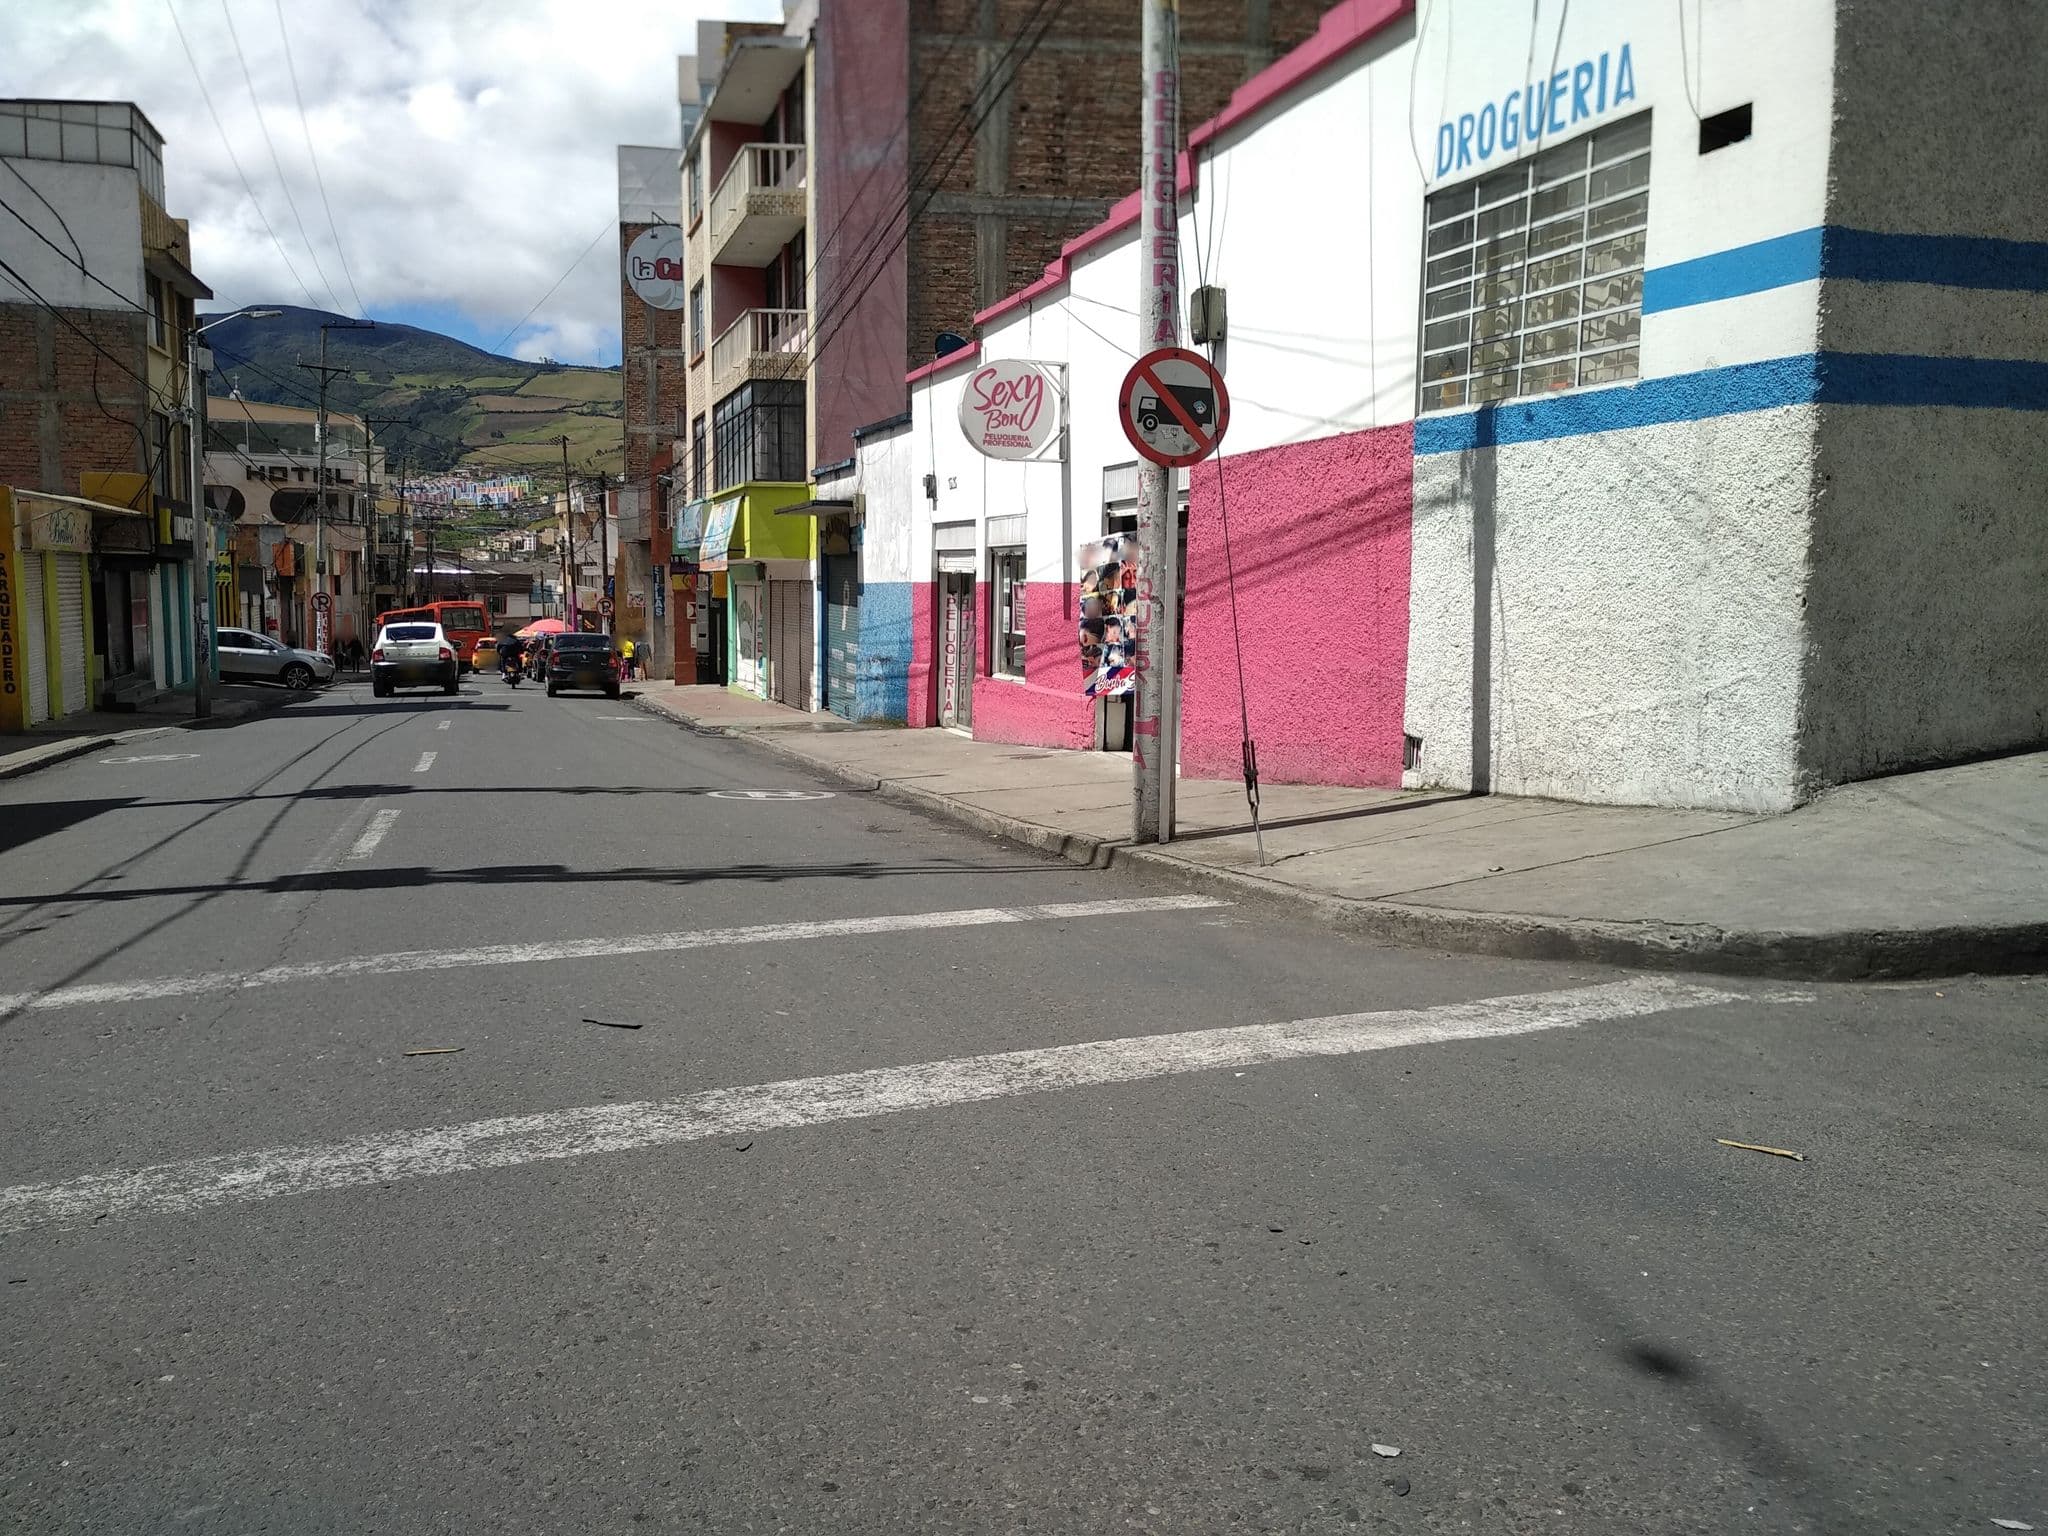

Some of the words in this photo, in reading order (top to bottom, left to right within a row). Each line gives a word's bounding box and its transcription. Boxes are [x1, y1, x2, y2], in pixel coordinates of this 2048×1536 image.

[1436, 43, 1635, 180] DROGUERIA
[1152, 70, 1177, 343] PELUQUERIA
[973, 367, 1044, 432] Sexy
[983, 409, 1020, 432] Bon
[982, 440, 1033, 448] PROFESIONAL
[984, 432, 1030, 442] PELUQUERIA
[246, 465, 356, 485] HOTEL
[944, 597, 956, 711] PELUQUERIA
